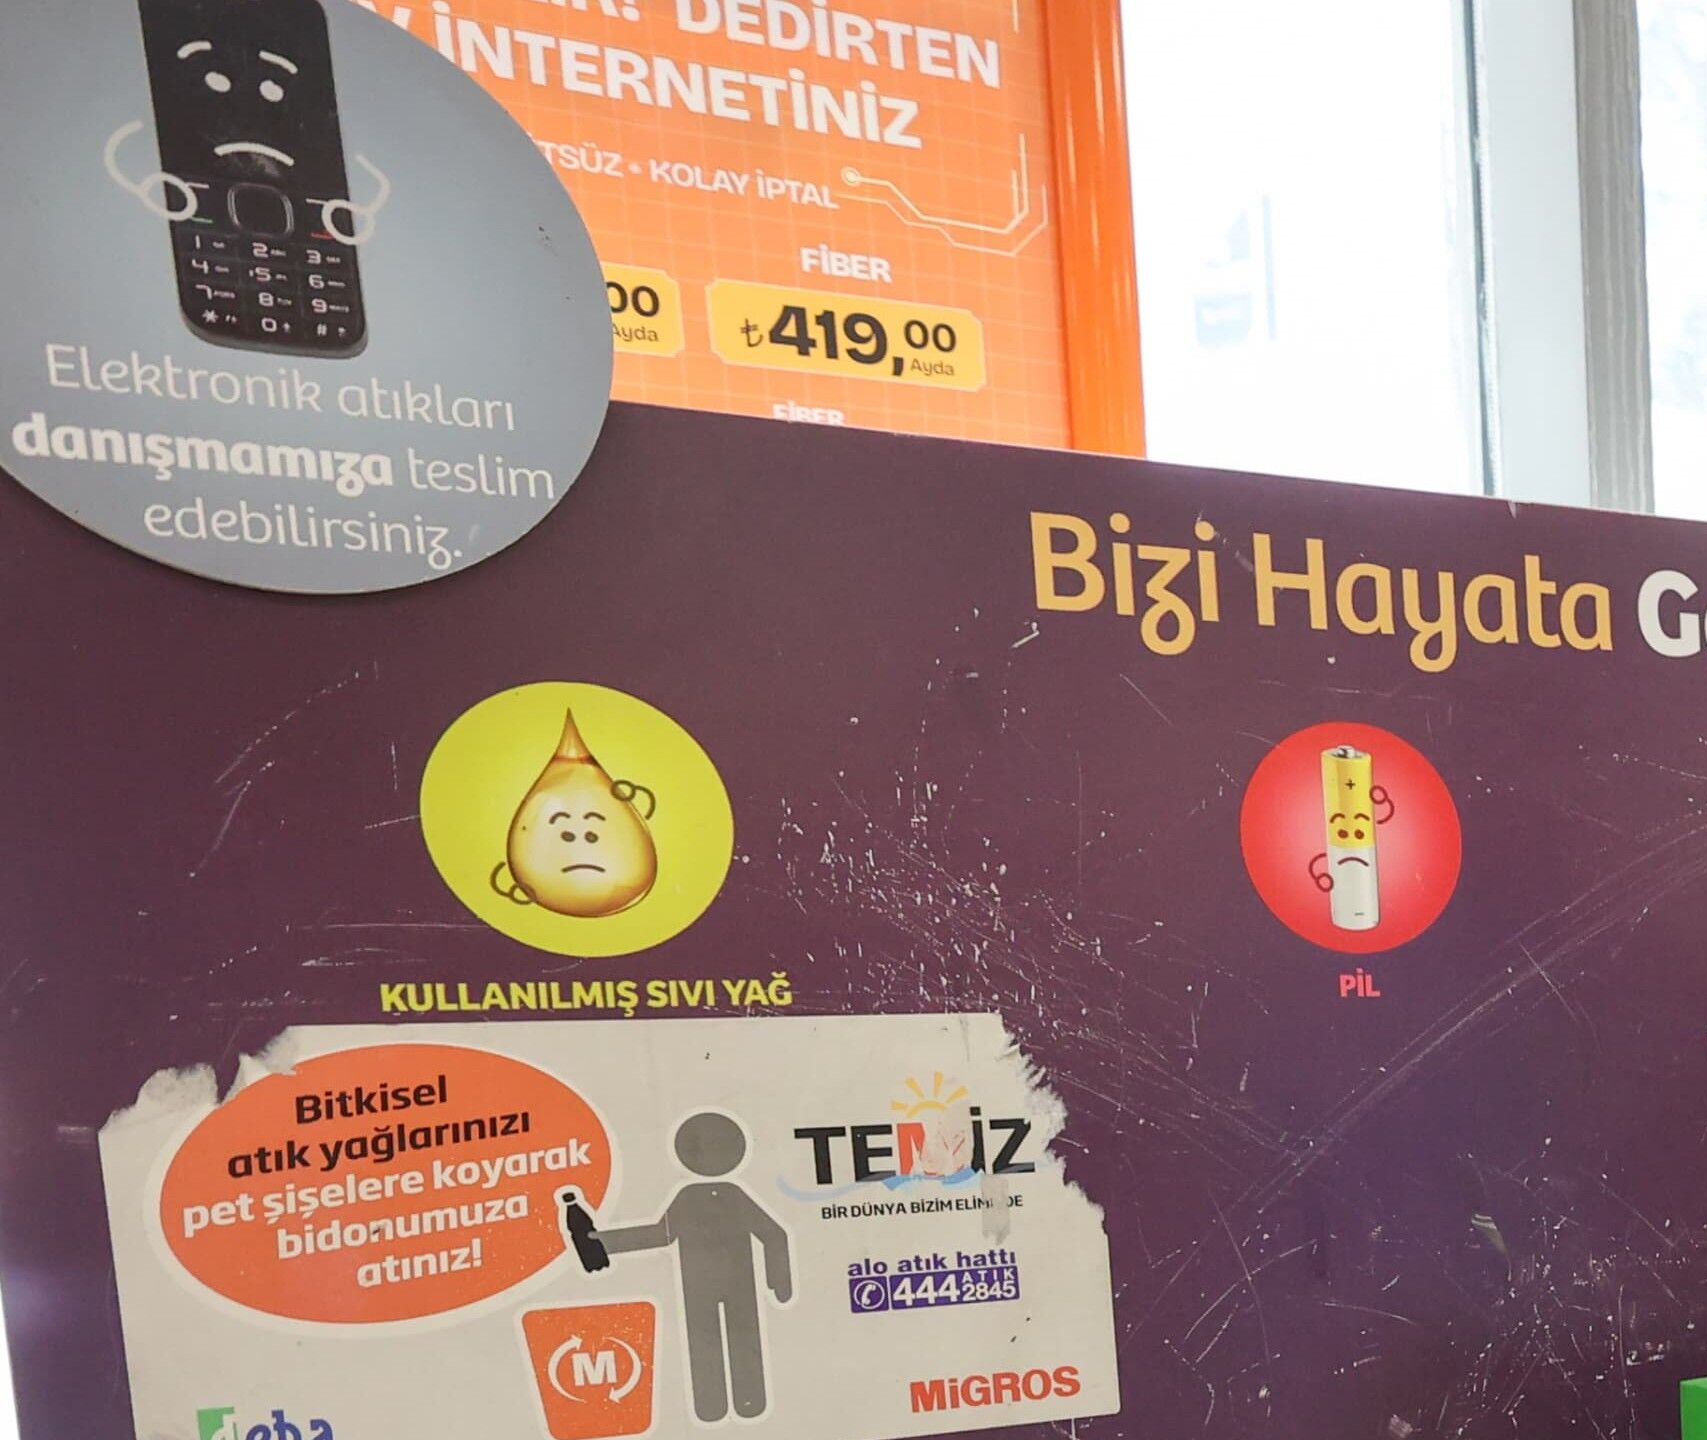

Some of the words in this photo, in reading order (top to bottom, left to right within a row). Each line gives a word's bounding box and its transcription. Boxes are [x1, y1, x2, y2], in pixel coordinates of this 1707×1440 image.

[676, 0, 1000, 89] DEDİRTEN
[432, 0, 922, 149] İNTERNETİNİZ
[649, 157, 749, 198] KOLAY
[755, 168, 839, 210] İPTAL
[800, 243, 892, 283] FİBER
[46, 344, 323, 413] Elektronik
[338, 376, 516, 432] atıkları
[910, 357, 955, 377] Ayda
[12, 412, 393, 497] danışmamıza
[407, 447, 555, 500] teslim
[143, 497, 463, 569] edebilirsiniz.
[1030, 511, 1220, 655] Bizi
[1253, 533, 1614, 673] Hayata
[380, 981, 640, 1017] KULLANILMIŞ
[646, 979, 717, 1009] SIVI
[722, 972, 793, 1007] YAĞ
[1339, 967, 1381, 998] PİL
[294, 1074, 448, 1125] Bitkisel
[227, 1141, 310, 1180] atık
[319, 1110, 531, 1173] yağlarınızı
[182, 1191, 254, 1239] pet
[262, 1167, 424, 1226] şişelere
[431, 1138, 591, 1191] koyarak
[821, 1205, 848, 1219] BİR
[851, 1201, 907, 1218] DÜNYA
[911, 1196, 953, 1214] BİZİM
[276, 1193, 529, 1261] bidonumuza
[356, 1238, 483, 1288] atınız!
[848, 1258, 888, 1277] alo
[897, 1253, 948, 1273] atık
[956, 1248, 1016, 1269] hattı
[962, 1267, 1017, 1284] ATIK
[892, 1275, 962, 1307] 444
[962, 1281, 1017, 1303] 2845
[571, 1351, 618, 1388] M
